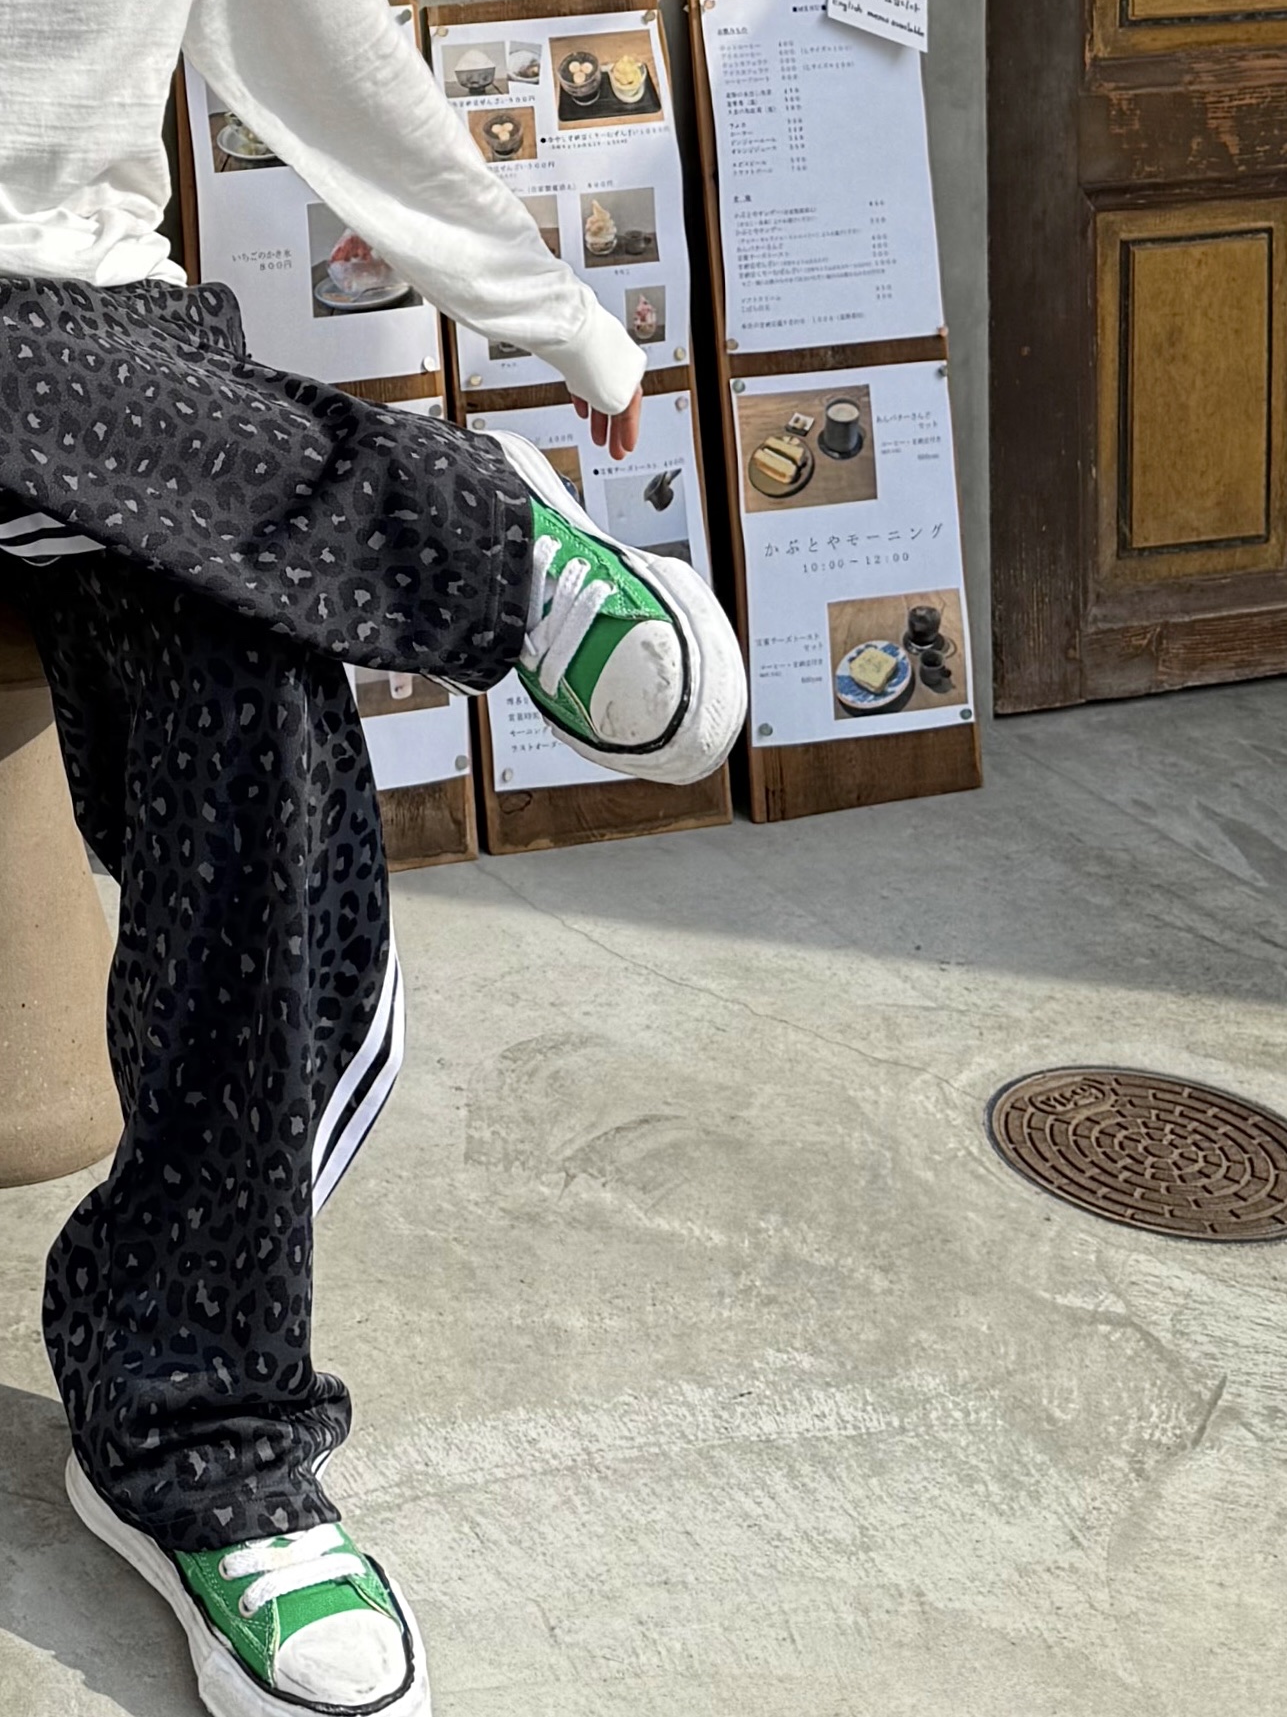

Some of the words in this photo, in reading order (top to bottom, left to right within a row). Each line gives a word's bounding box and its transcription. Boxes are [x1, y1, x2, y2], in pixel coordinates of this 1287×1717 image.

[867, 10, 890, 24] menu
[232, 249, 292, 263] いちごのかき氷
[765, 523, 944, 557] かぶとやモーニング
